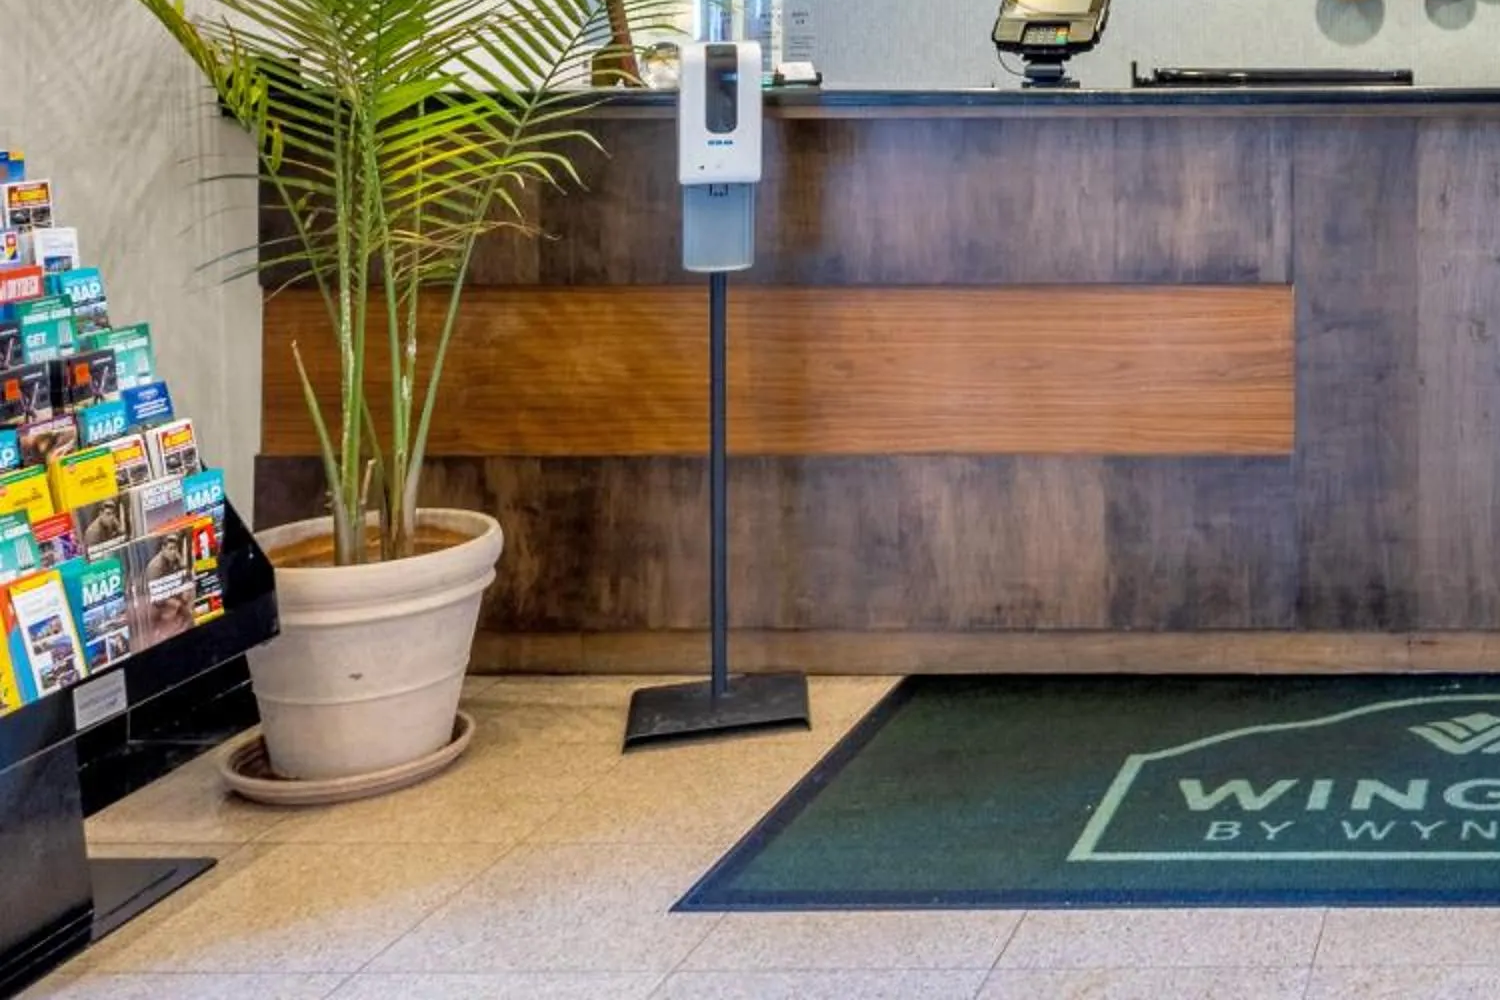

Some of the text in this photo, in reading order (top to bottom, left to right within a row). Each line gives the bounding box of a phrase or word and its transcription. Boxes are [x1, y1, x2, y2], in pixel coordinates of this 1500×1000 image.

[88, 416, 126, 443] MAP
[187, 484, 221, 512] MAP
[83, 574, 121, 607] MAP
[1203, 820, 1295, 842] BY
